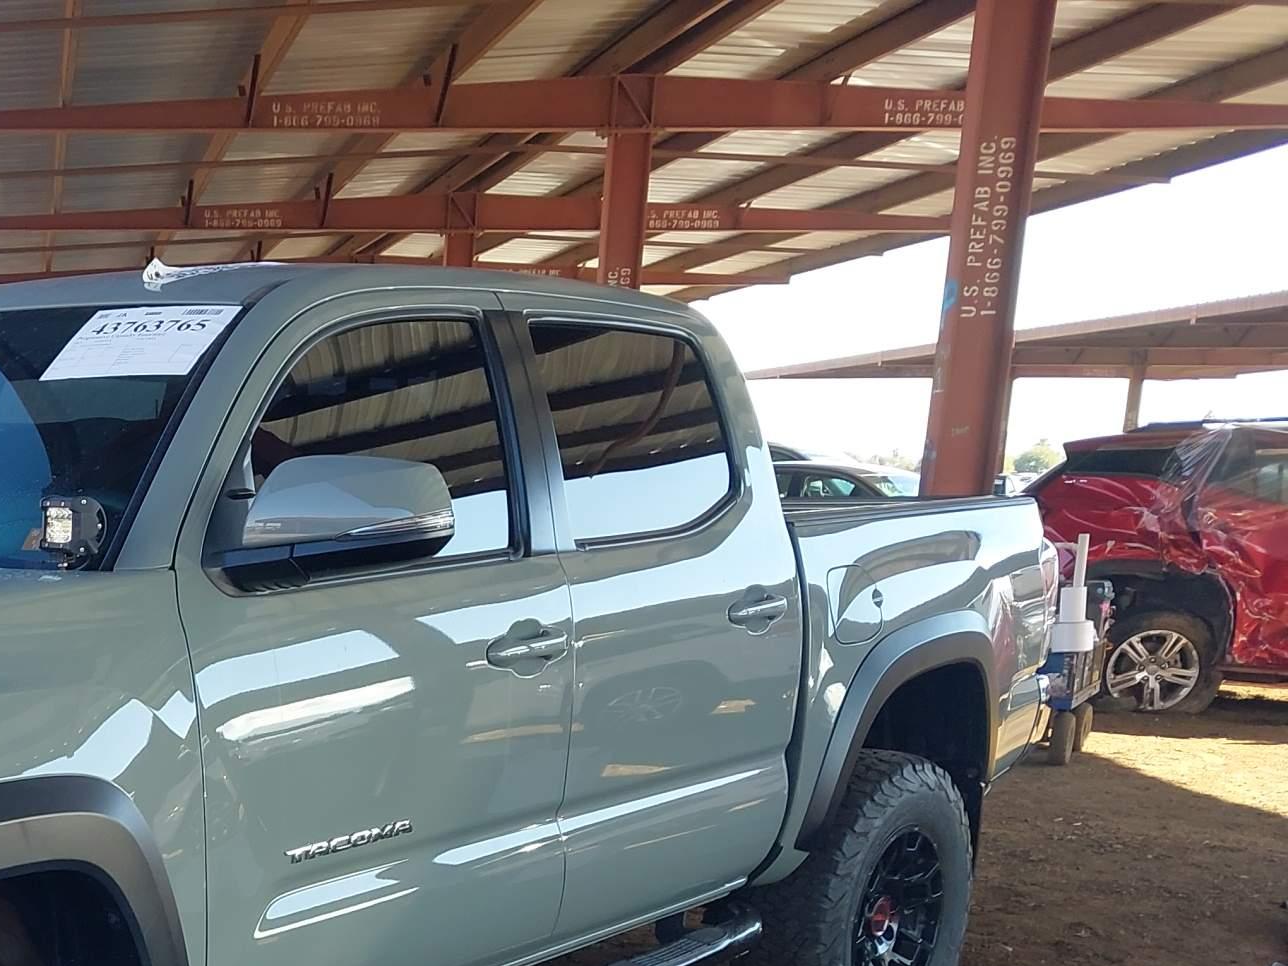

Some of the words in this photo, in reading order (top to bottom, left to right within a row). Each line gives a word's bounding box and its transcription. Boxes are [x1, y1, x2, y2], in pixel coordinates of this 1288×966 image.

[303, 101, 351, 113] PREFAB
[884, 99, 909, 111] U.S.
[915, 99, 965, 111] PREFAB
[977, 135, 998, 174] INC.
[966, 186, 992, 266] PREFAB
[980, 136, 1016, 316] 1-866-799-0969
[960, 279, 981, 317] U.S.
[90, 318, 211, 336] 43763765
[284, 819, 414, 864] TACOMA
